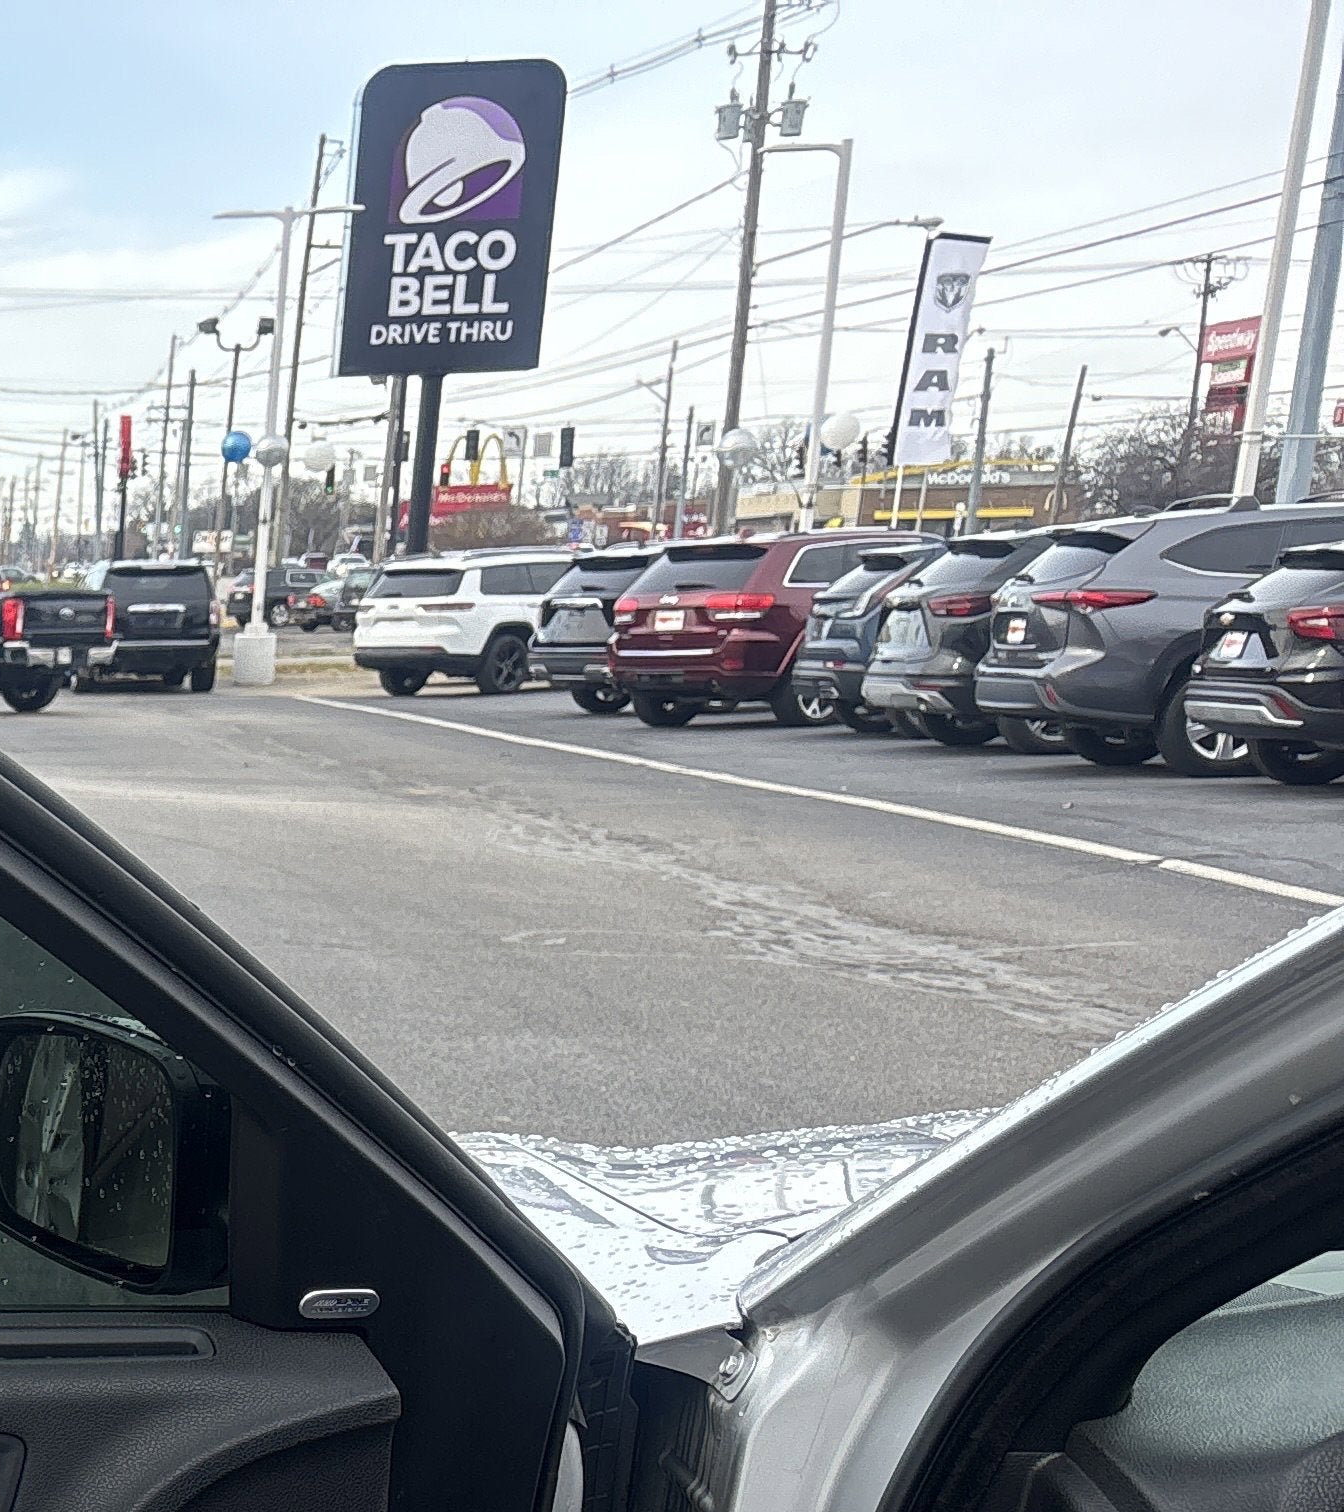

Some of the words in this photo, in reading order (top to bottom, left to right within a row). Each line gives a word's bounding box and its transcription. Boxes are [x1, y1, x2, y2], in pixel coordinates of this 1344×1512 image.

[383, 229, 517, 273] TACO
[387, 274, 510, 317] BELL
[369, 322, 441, 346] DRIVE
[446, 320, 513, 343] THRU
[908, 332, 959, 427] RAM
[927, 471, 1011, 485] McDold's
